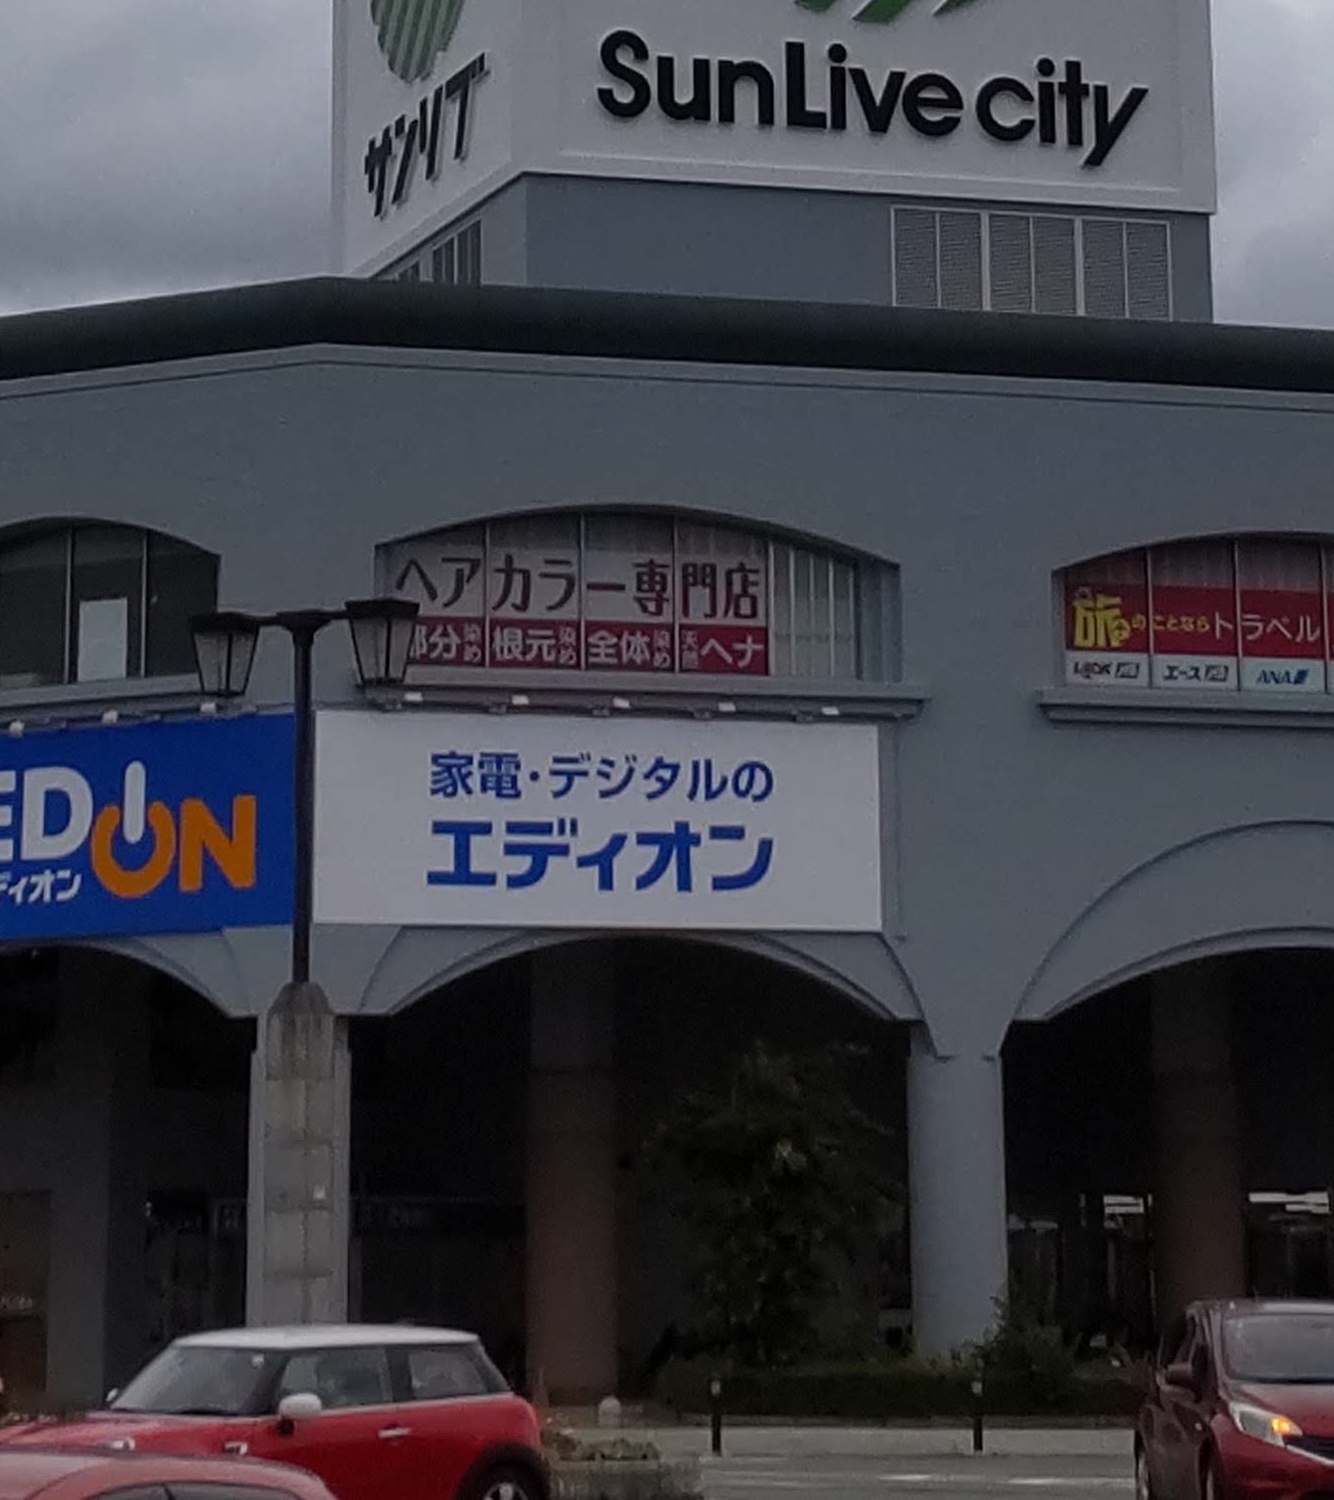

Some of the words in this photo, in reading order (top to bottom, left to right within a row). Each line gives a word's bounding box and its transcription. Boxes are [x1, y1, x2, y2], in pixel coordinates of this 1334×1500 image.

[364, 51, 486, 218] サンリブ
[596, 29, 965, 137] SunLive
[977, 57, 1149, 168] city
[395, 553, 761, 620] ヘアカラー専門店
[430, 751, 774, 803] 家電・デジタルの
[426, 817, 774, 894] エディオン
